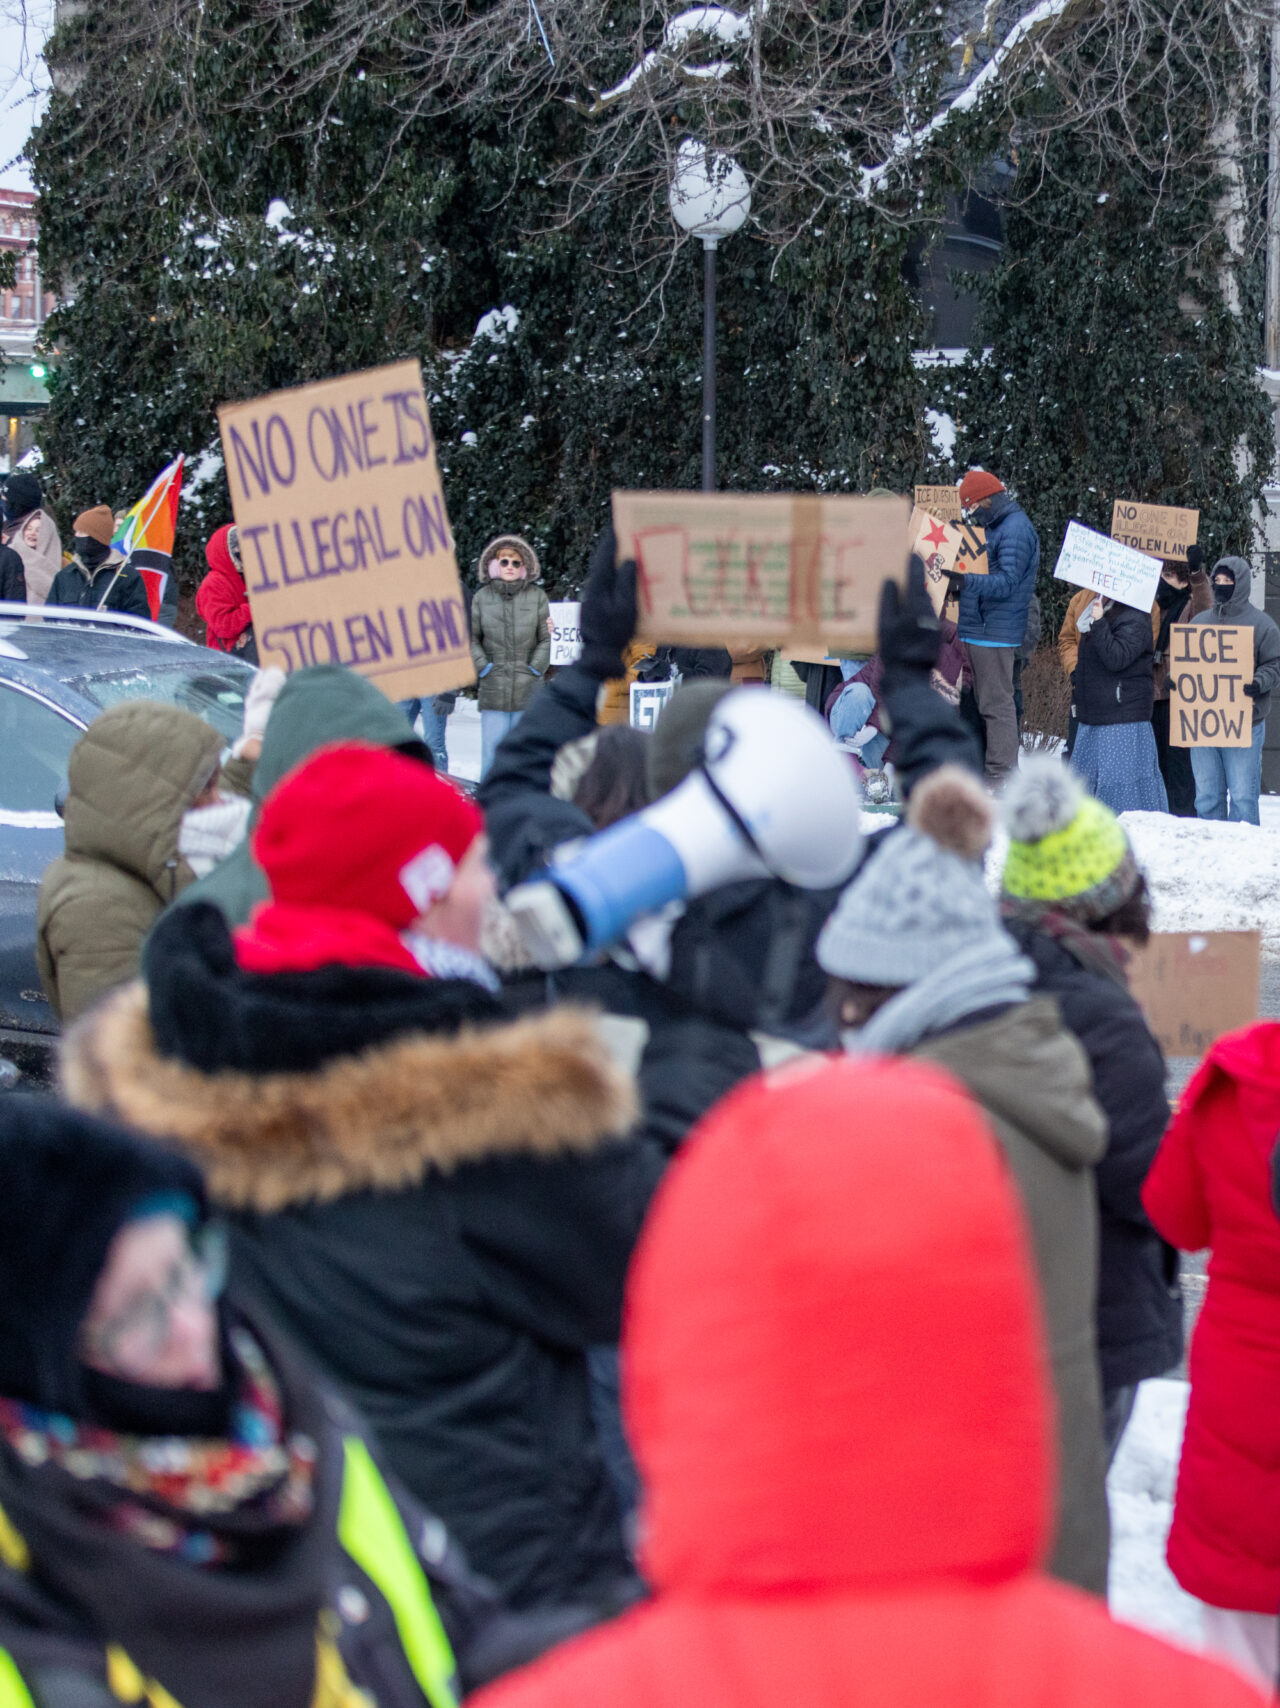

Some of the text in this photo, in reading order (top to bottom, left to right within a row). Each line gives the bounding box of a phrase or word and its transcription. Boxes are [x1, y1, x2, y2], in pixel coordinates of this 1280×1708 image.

[229, 390, 432, 500] NO ONE IS
[916, 488, 931, 503] ICE
[1116, 505, 1189, 528] NO ONE IS
[241, 493, 449, 594] ILLEGAL ON
[1112, 533, 1162, 552] STOLEN
[1163, 541, 1188, 556] LAN
[261, 597, 467, 674] STOLEN LAND
[1173, 627, 1239, 663] ICE
[1177, 673, 1243, 703] OUT
[1179, 708, 1245, 742] NOW
